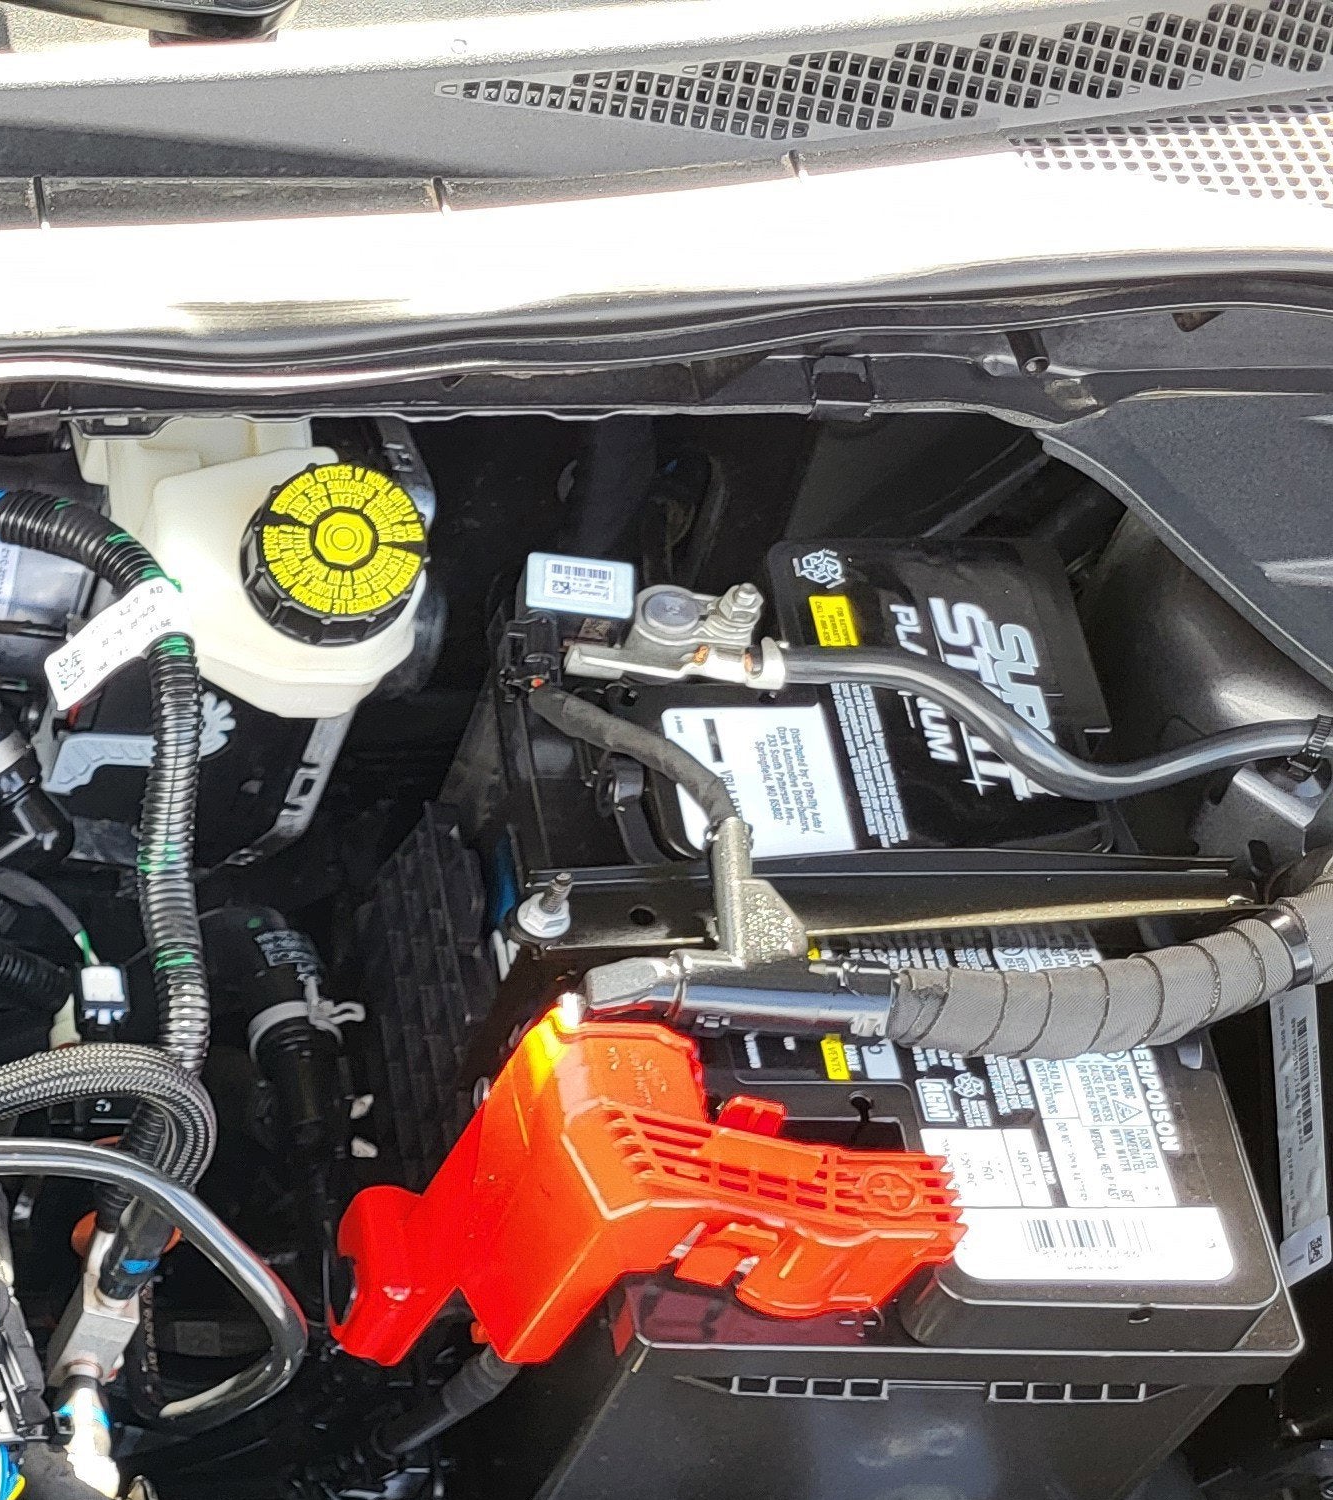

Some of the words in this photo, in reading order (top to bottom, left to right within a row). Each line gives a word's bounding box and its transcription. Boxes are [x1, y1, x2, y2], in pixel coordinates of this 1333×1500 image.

[331, 494, 364, 508] CLEAN
[889, 604, 957, 761] PLNUM
[766, 734, 778, 747] 233
[776, 727, 789, 745] Ozark
[769, 750, 782, 770] South
[782, 748, 798, 787] Automotive
[775, 772, 791, 804] Patterson
[789, 728, 808, 767] Distributed
[802, 782, 817, 810] O'Reilly
[811, 812, 822, 828] Auto
[765, 785, 777, 797] MO
[769, 799, 783, 821] 65802
[1075, 1064, 1086, 1073] OR
[1088, 1064, 1103, 1084] CAUSE
[1101, 1065, 1116, 1081] ACID
[1035, 1060, 1058, 1115] INSTRUCTIONS
[1052, 1082, 1064, 1094] ALL
[1079, 1076, 1095, 1098] SEVERE
[1106, 1083, 1119, 1096] CAN
[1115, 1064, 1136, 1099] SULFURIC
[920, 1082, 950, 1117] AGM
[1095, 1087, 1114, 1121] BLINDNESS
[1132, 1044, 1179, 1151] ER/POISON
[1086, 1101, 1102, 1122] BURNS
[1089, 1129, 1107, 1159] MEDICAL
[1110, 1129, 1125, 1146] WITH
[1136, 1129, 1152, 1149] FLUSH
[1115, 1149, 1132, 1172] WATER
[1123, 1129, 1146, 1174] IMMEDIATELY
[1143, 1153, 1158, 1168] EYES
